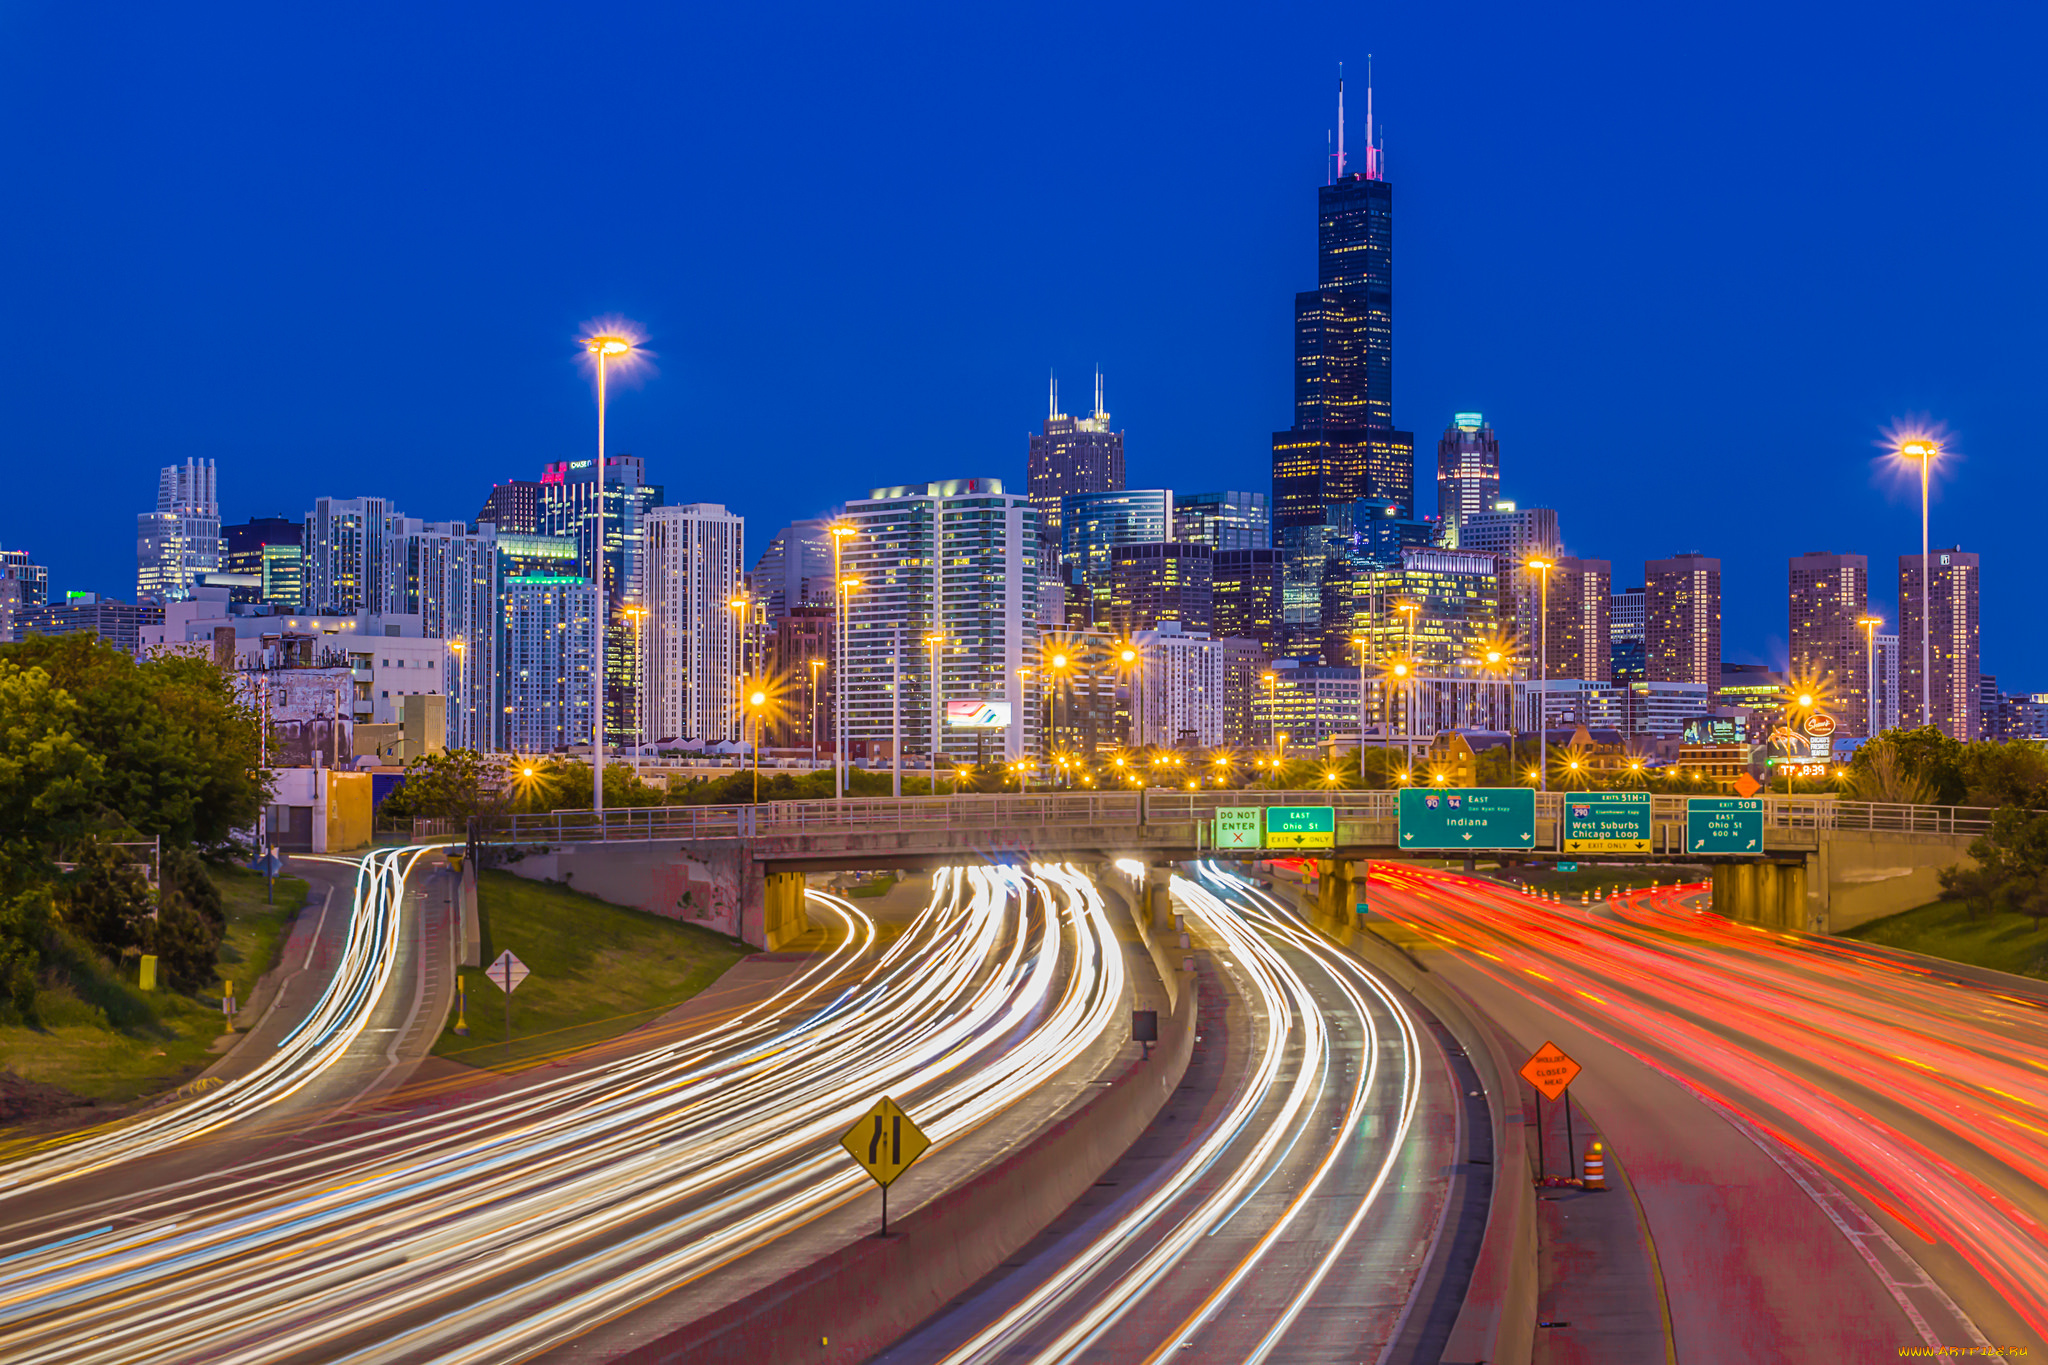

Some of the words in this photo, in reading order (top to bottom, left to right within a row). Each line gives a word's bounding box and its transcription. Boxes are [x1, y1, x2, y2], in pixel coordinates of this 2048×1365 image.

[1802, 764, 1825, 776] 8:39
[1426, 800, 1438, 808] 90
[1448, 800, 1460, 808] 94
[1738, 801, 1757, 809] 50B
[1220, 811, 1233, 819] DO
[1237, 811, 1256, 819] NOT
[1574, 808, 1588, 817] 290
[1221, 822, 1256, 830] ENTER
[1282, 822, 1303, 830] Ohio
[1308, 822, 1319, 830] St
[1446, 818, 1488, 827] Indiana
[1572, 821, 1596, 829] West
[1600, 821, 1639, 829] Suburbs
[1708, 821, 1729, 829] Ohio
[1733, 821, 1742, 829] St
[1572, 830, 1611, 839] Chicago
[1615, 830, 1639, 840] Loop
[1536, 1067, 1567, 1077] CLOSED
[1544, 1078, 1563, 1086] AHEAD
